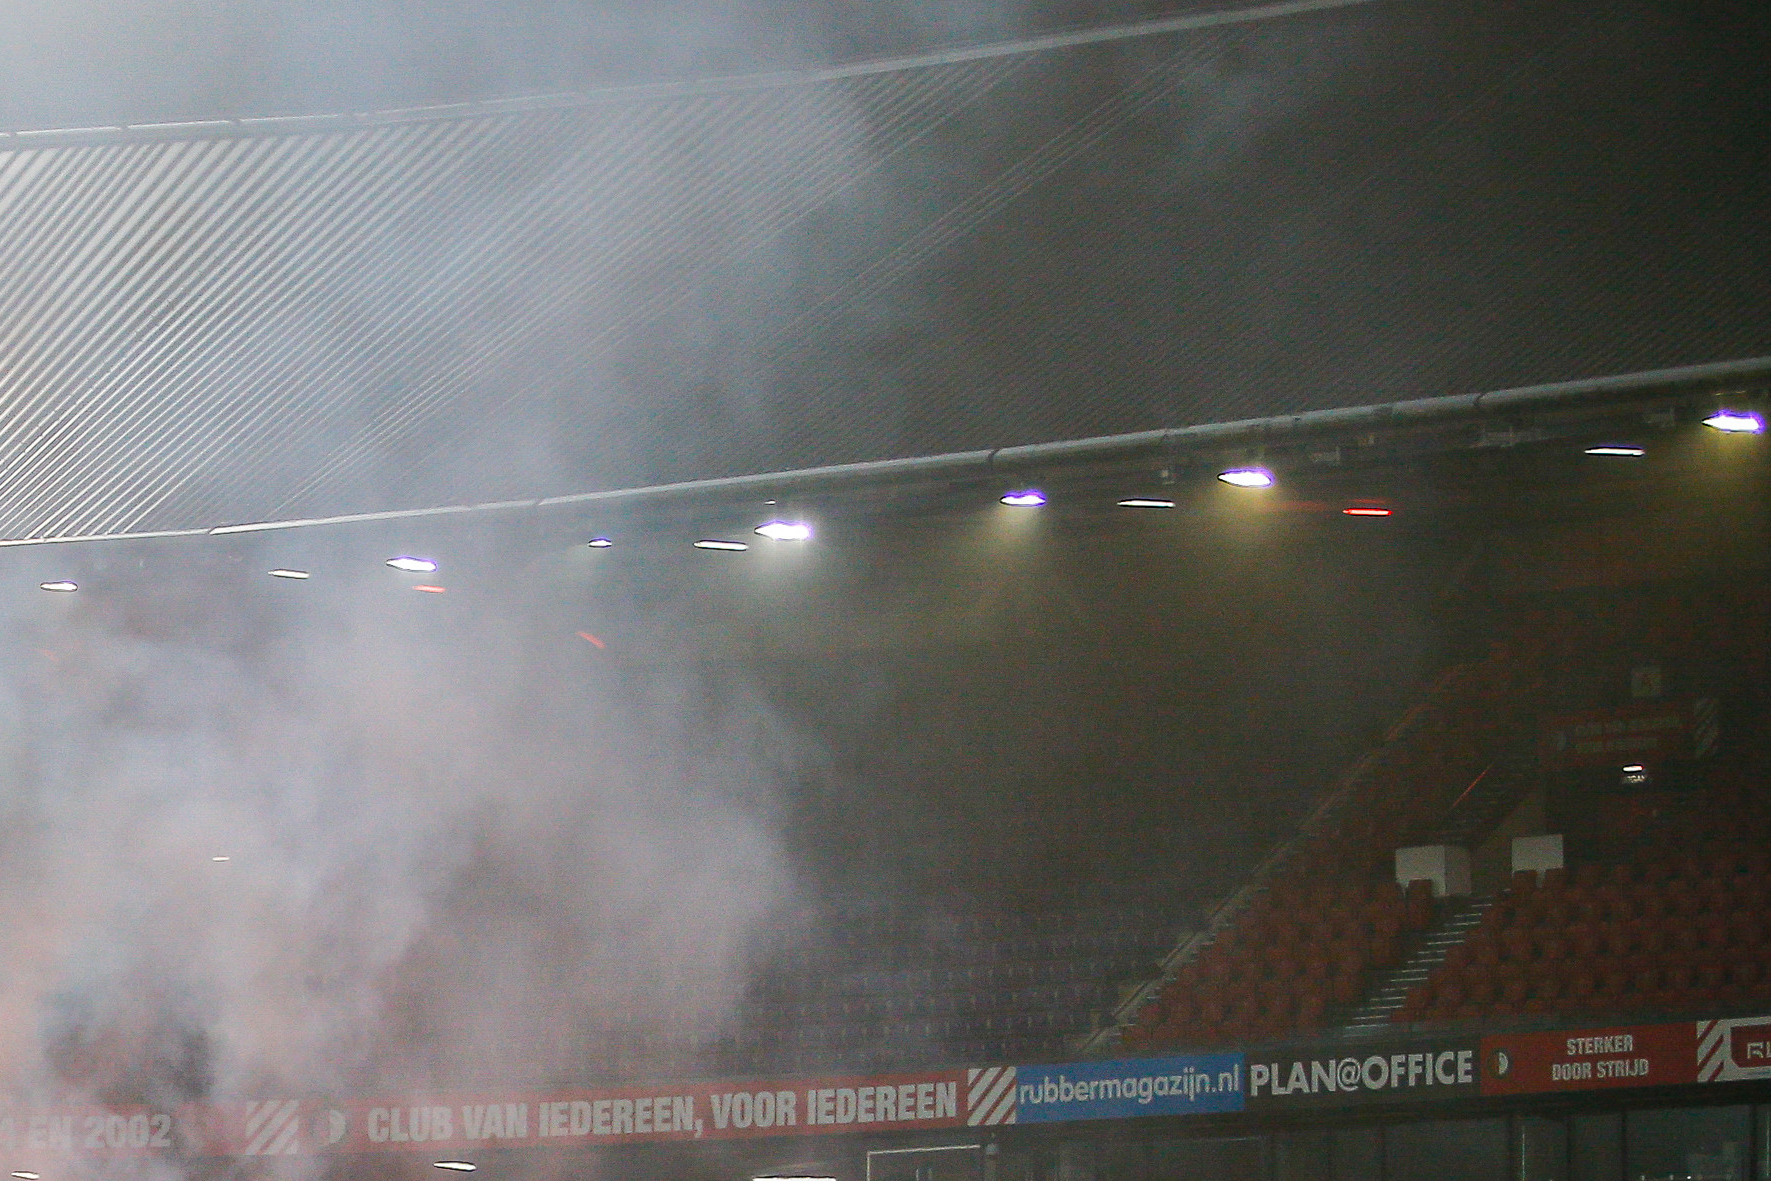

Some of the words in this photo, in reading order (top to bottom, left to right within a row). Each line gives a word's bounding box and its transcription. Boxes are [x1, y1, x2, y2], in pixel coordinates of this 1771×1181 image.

[1566, 1035, 1634, 1056] STERKER
[1018, 1063, 1240, 1106] rubbermagazijn.nl
[1249, 1050, 1474, 1096] PLAN@OFFICE
[1552, 1062, 1592, 1081] DOOR
[1596, 1058, 1649, 1079] STRIJD
[84, 1113, 171, 1149] 2002
[367, 1105, 454, 1144] CLUB
[462, 1102, 527, 1140] VAN
[538, 1092, 705, 1138] IEDEREEN,
[711, 1089, 797, 1129] VOOR
[806, 1080, 958, 1125] IEDEREEN
